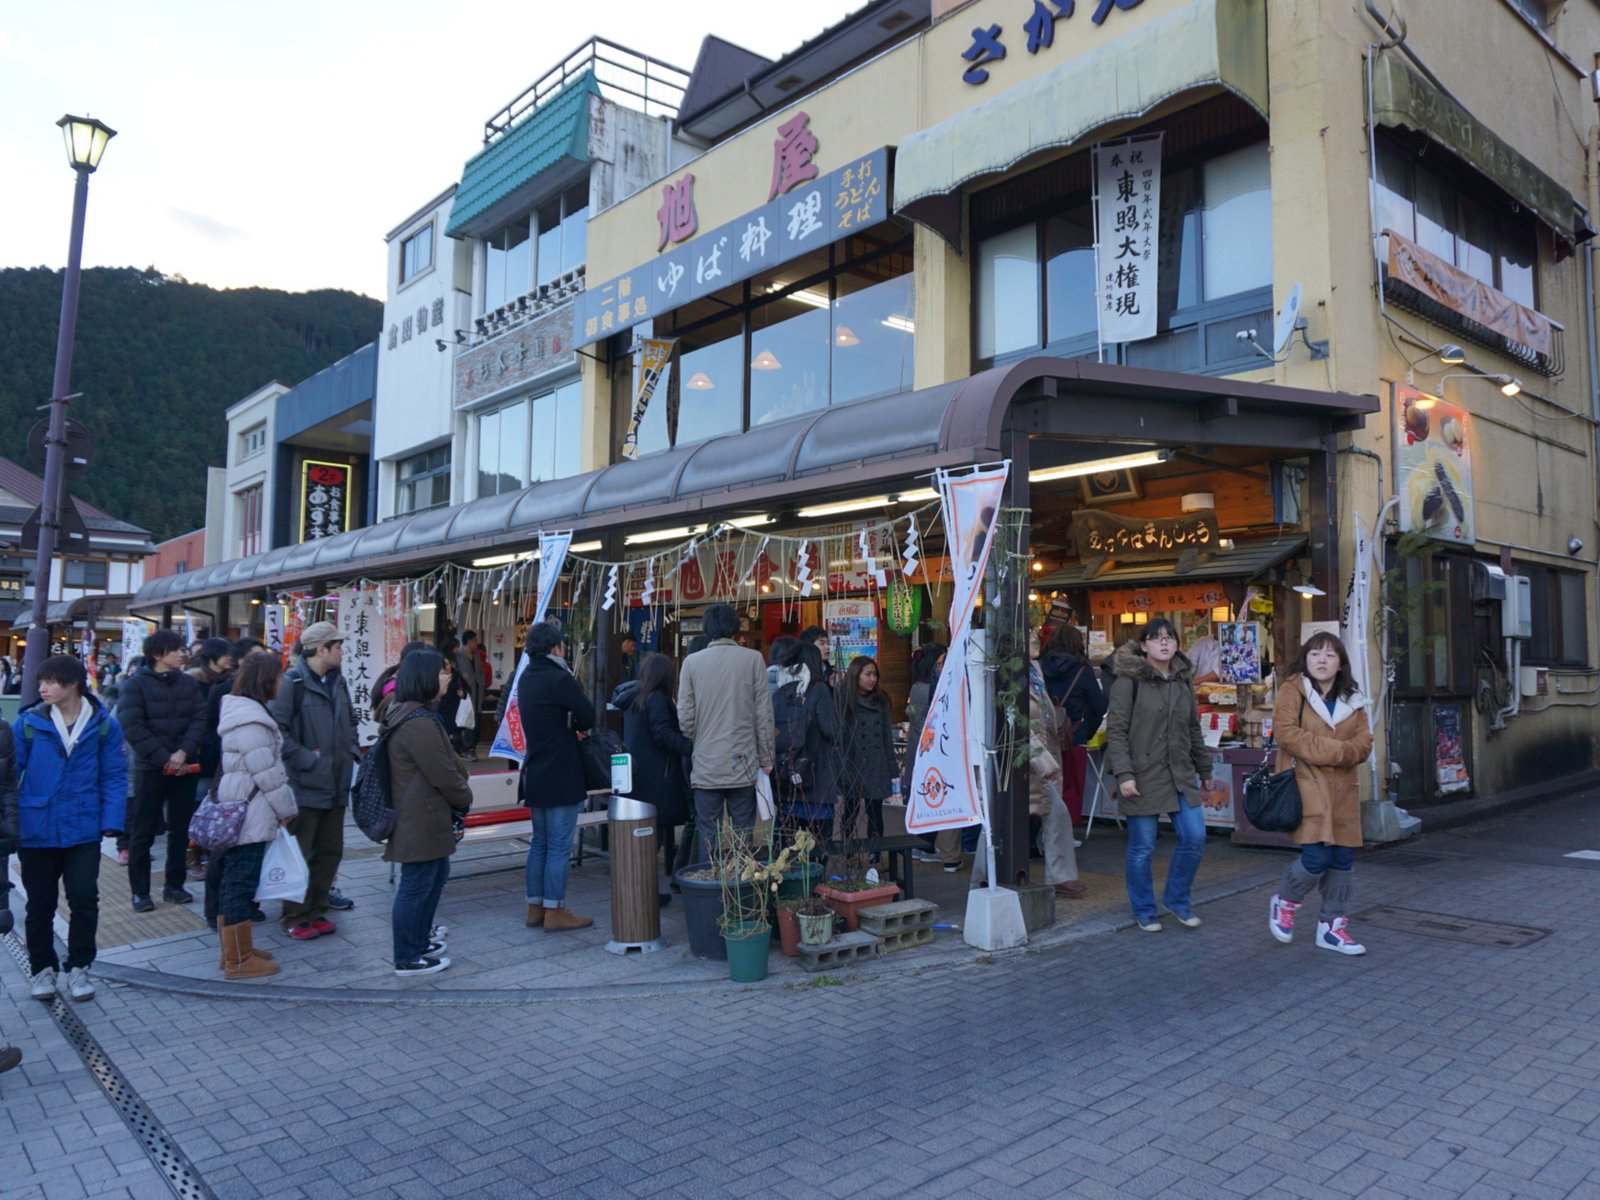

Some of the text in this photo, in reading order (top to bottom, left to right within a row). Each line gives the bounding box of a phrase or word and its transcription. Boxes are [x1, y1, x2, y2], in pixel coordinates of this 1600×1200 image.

[961, 0, 1145, 85] さか
[841, 159, 872, 188] 手打
[1110, 150, 1144, 168] 奉祝
[657, 111, 820, 253] 旭屋
[834, 176, 880, 208] うどん
[837, 198, 873, 229] そば
[657, 190, 823, 298] ゆば料理
[1114, 169, 1141, 317] 東照大権現
[601, 276, 632, 305] 二階
[319, 468, 337, 481] 2F
[327, 485, 342, 535] お食事処
